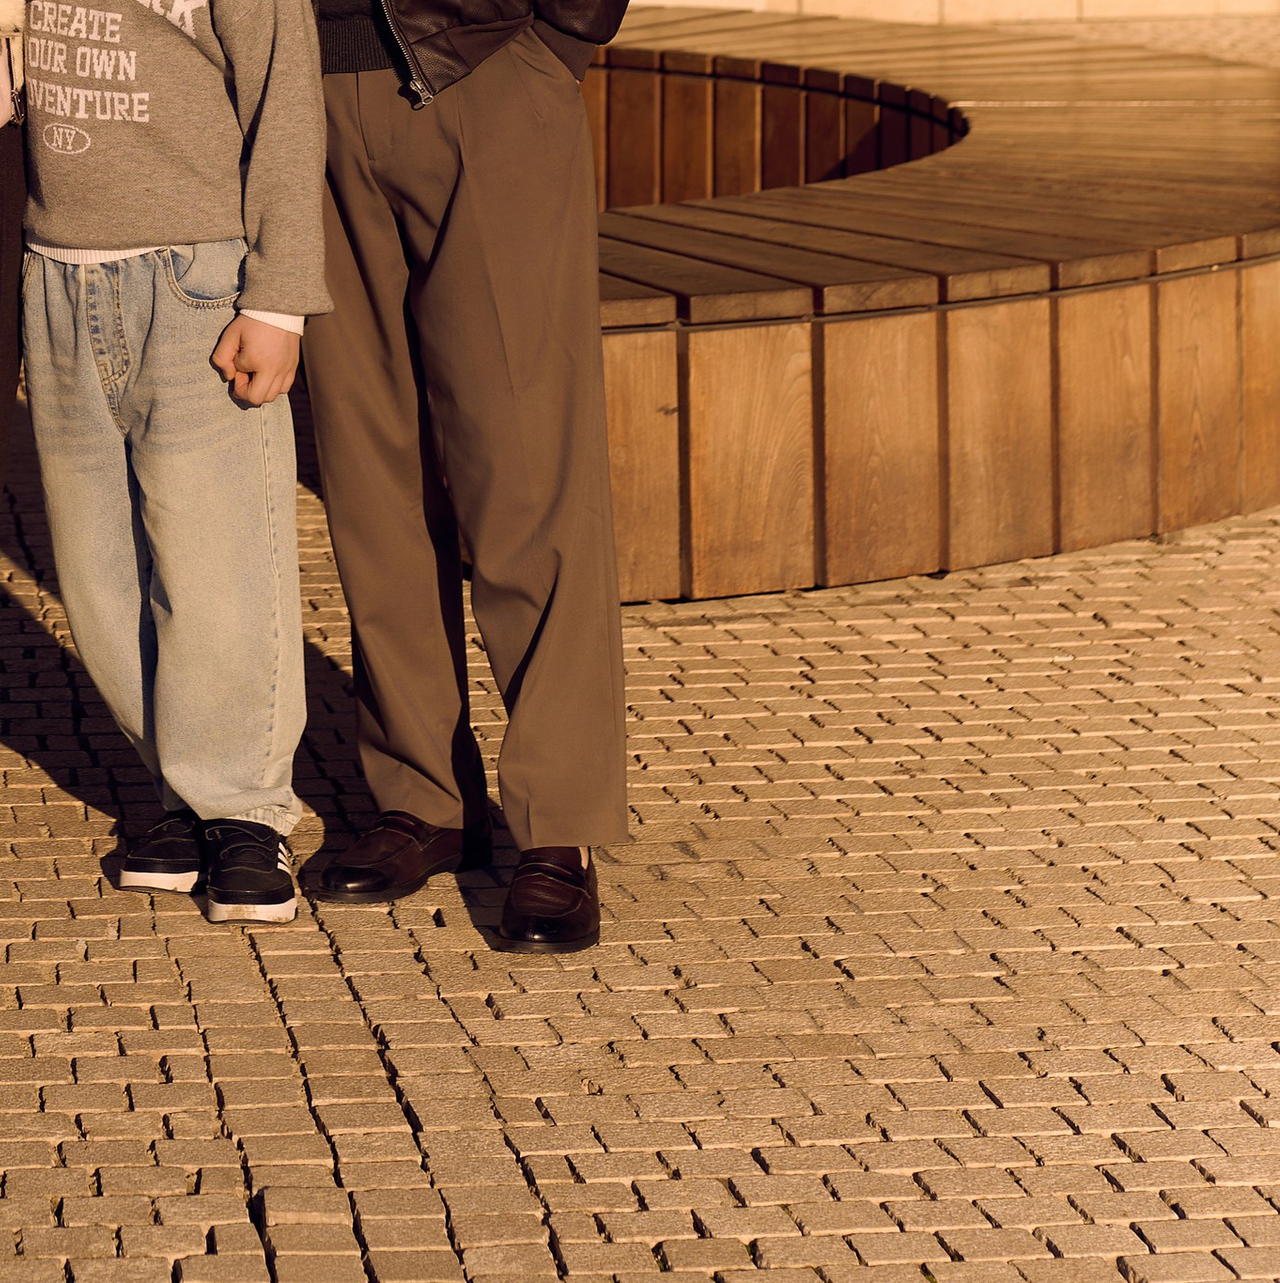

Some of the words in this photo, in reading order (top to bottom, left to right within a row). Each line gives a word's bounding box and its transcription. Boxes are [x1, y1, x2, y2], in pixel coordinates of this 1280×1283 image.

[29, 0, 123, 43] CREATE
[25, 37, 68, 75] OUR
[76, 46, 137, 81] OWN
[52, 126, 77, 151] NY
